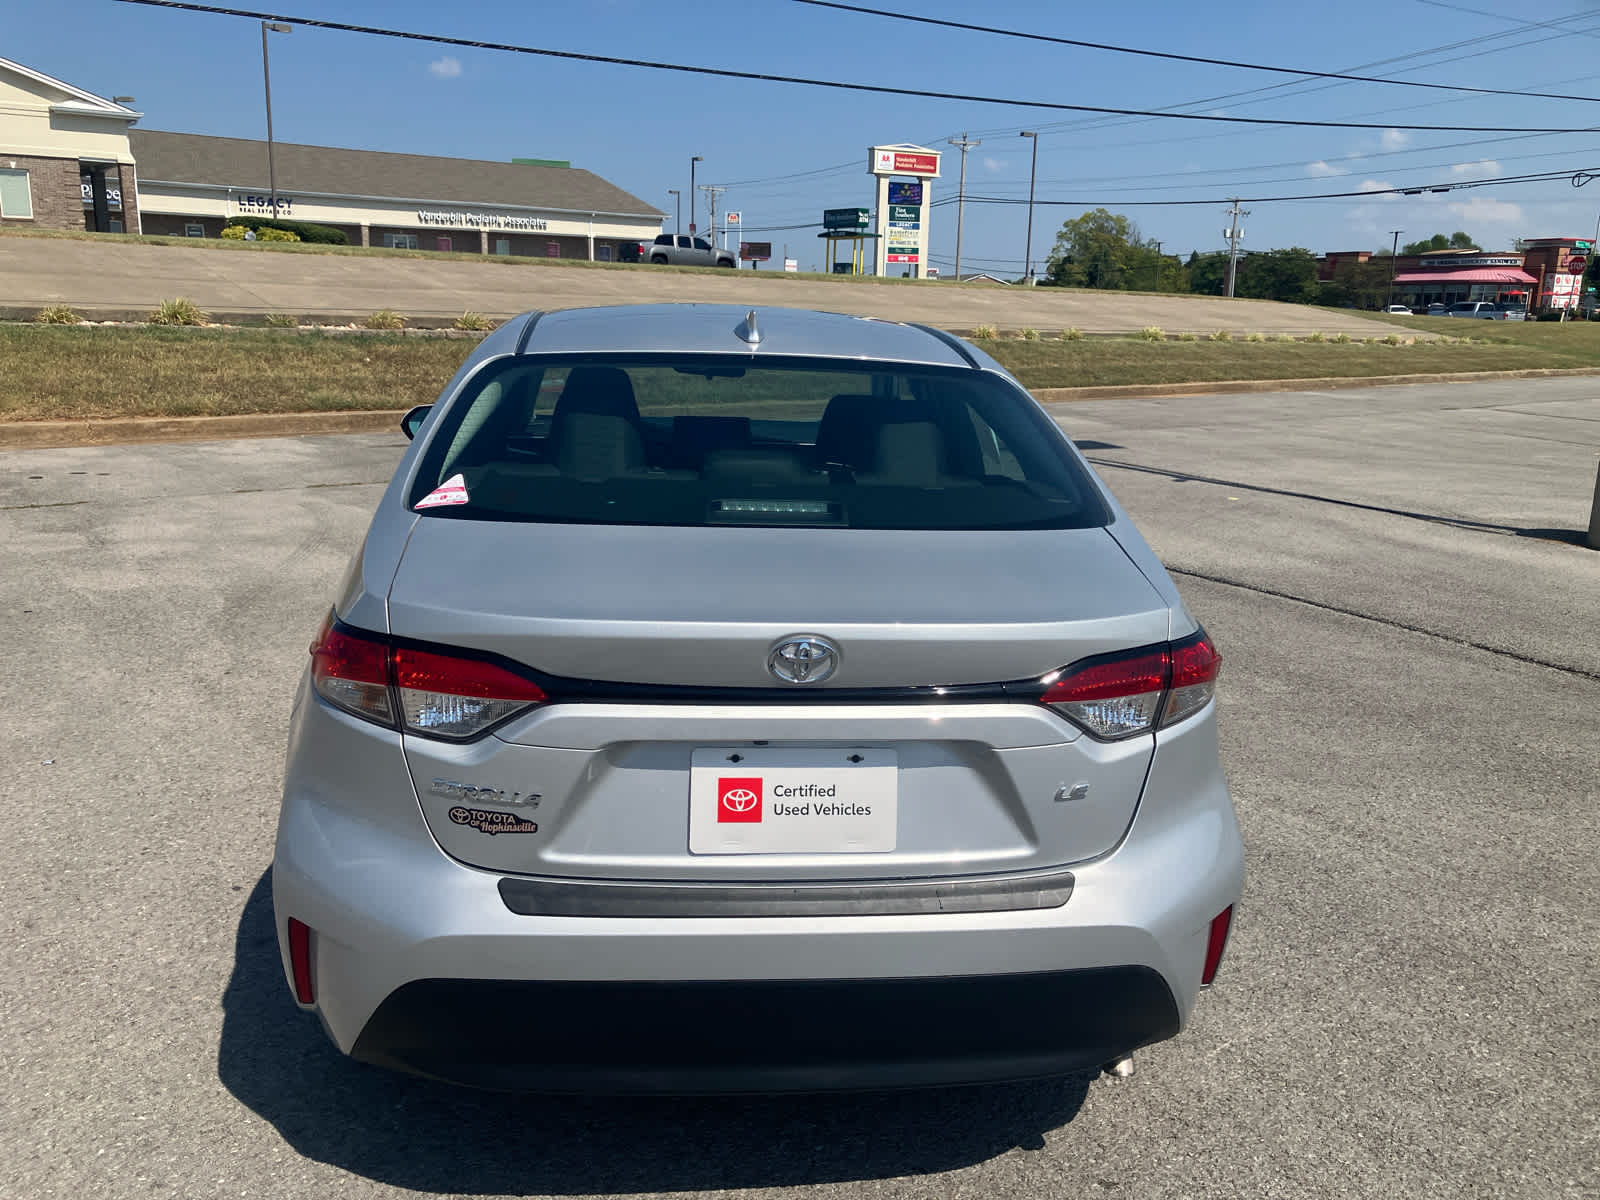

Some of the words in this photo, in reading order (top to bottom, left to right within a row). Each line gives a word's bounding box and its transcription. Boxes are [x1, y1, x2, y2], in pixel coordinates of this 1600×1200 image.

[238, 195, 292, 209] LEGACY
[418, 210, 465, 225] Vanderbilt
[1570, 262, 1586, 270] STOP
[773, 784, 837, 798] Certified
[773, 802, 810, 816] Used
[813, 802, 873, 816] Vehicles
[471, 810, 516, 824] TOYOTA
[481, 822, 536, 833] Hopkinsville
